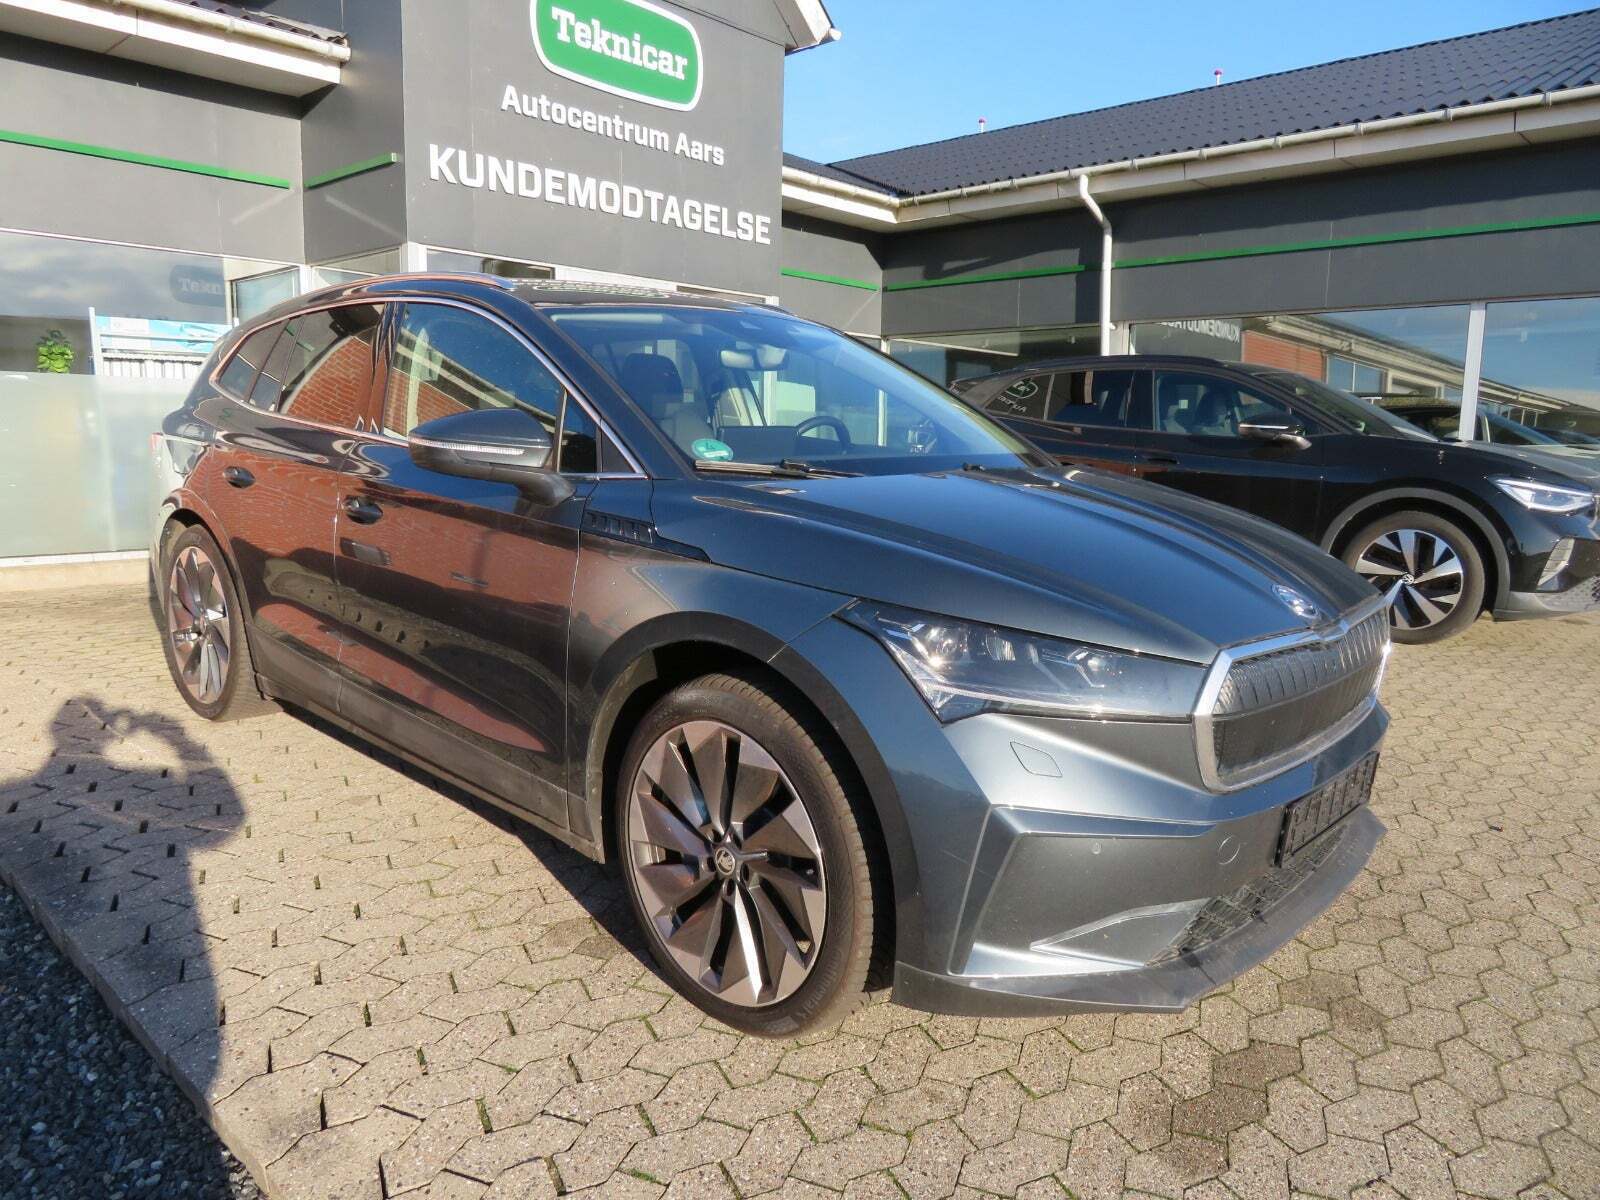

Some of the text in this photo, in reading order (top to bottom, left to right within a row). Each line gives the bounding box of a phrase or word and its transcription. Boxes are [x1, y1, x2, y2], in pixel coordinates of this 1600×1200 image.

[551, 6, 688, 81] Teknicar
[501, 85, 725, 167] Autocentrum Aars
[428, 143, 771, 246] KUNDEMODTAGELSE
